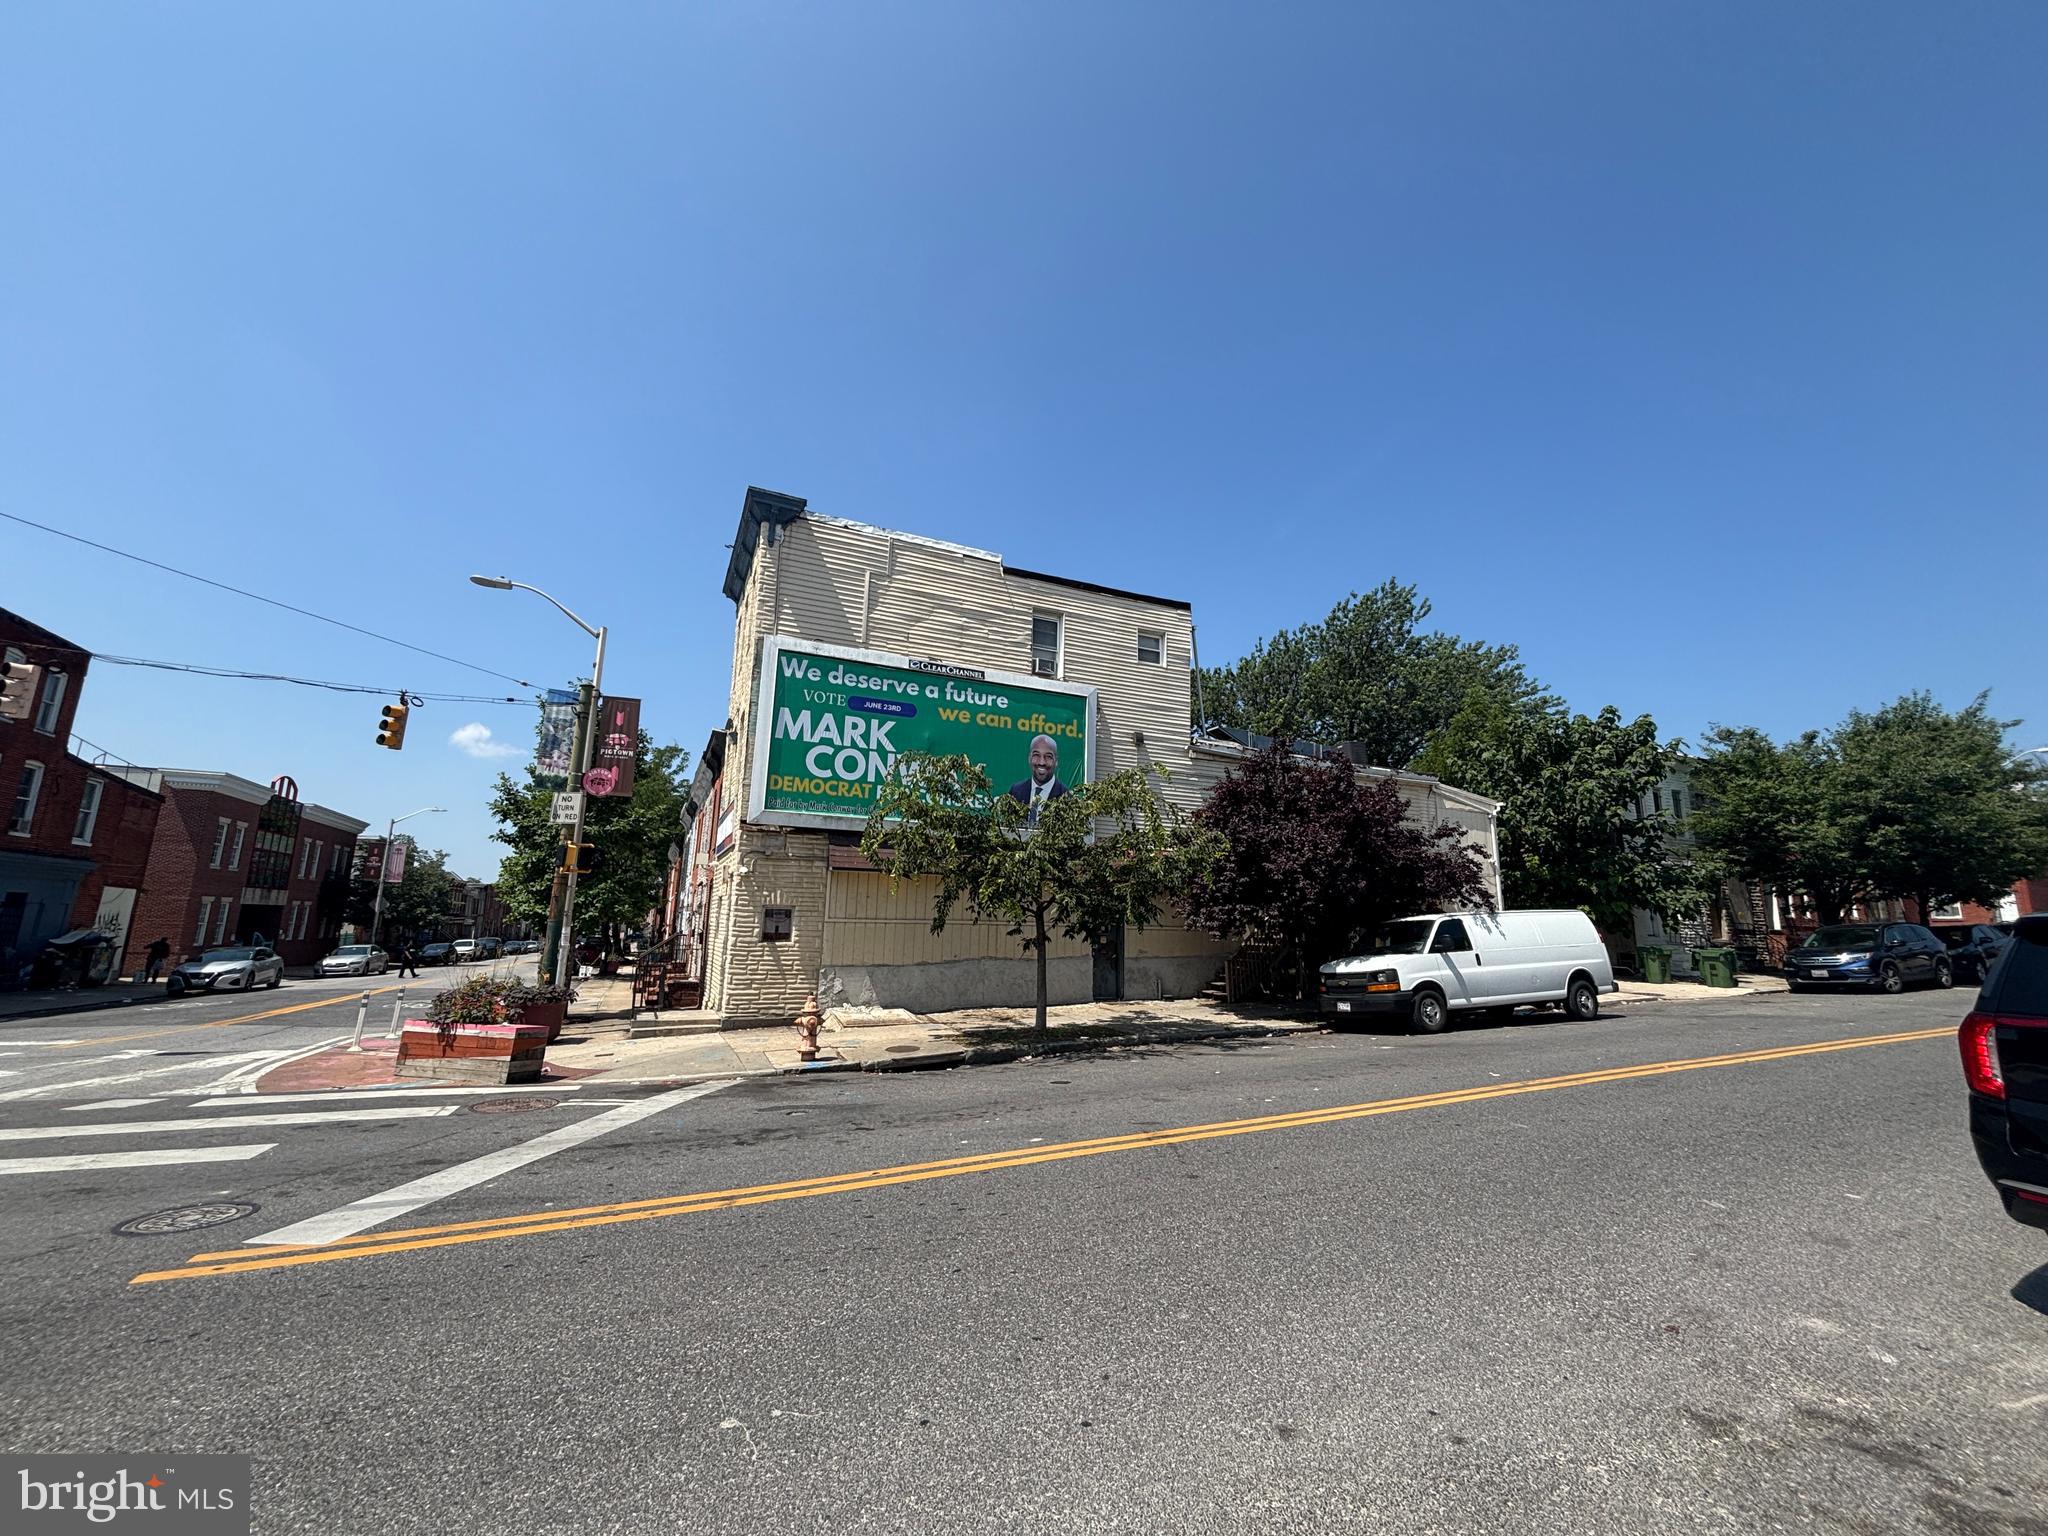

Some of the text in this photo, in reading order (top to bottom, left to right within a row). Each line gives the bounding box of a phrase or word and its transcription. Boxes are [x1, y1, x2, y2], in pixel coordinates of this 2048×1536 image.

[780, 656, 1009, 708] We deserve a future
[803, 689, 847, 707] VOTE
[864, 701, 902, 712] JUNE 23RD
[774, 706, 897, 752] MARK
[938, 707, 1083, 738] we can afford.
[768, 775, 872, 799] DEMOCRAT
